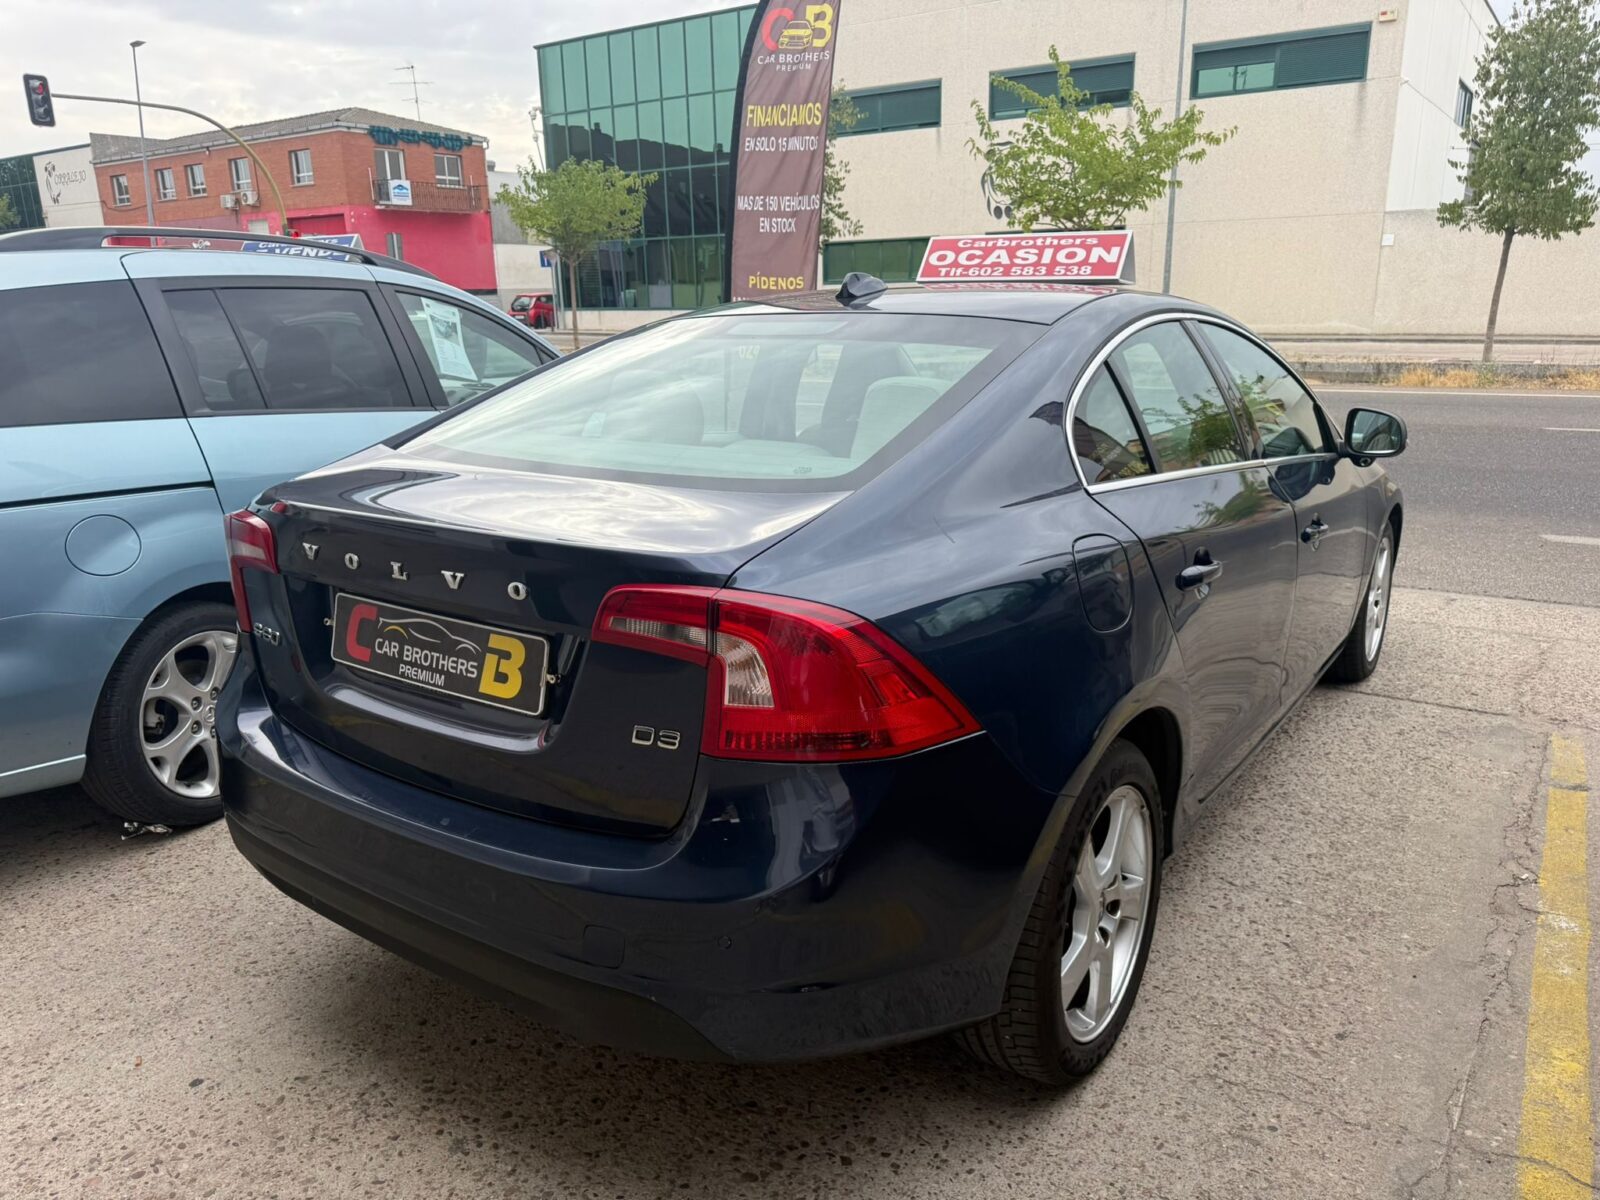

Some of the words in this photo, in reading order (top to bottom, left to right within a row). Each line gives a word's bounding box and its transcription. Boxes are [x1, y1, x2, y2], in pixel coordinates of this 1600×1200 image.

[757, 54, 776, 65] CAR
[778, 50, 830, 64] BROTHERS
[746, 102, 822, 127] FINANCIAMOS
[744, 137, 755, 152] EN
[755, 136, 776, 152] SOLO
[778, 137, 787, 152] 15
[787, 135, 819, 151] MINUTOS
[737, 195, 753, 210] MAS
[753, 195, 764, 211] DE
[765, 195, 779, 211] 150
[779, 192, 820, 212] VEHÍCULOS
[759, 217, 770, 233] EN
[771, 217, 796, 233] STOCK
[957, 236, 1099, 248] Carbrothers
[928, 246, 1121, 267] OCASION
[1009, 266, 1047, 276] 583
[1053, 265, 1092, 276] 538
[748, 272, 804, 290] PÍDENOS
[302, 542, 527, 601] VOLVO
[374, 637, 400, 659] CAR
[402, 647, 479, 679] BROTHERS
[398, 663, 446, 688] PREMIUM
[631, 724, 681, 750] D3
